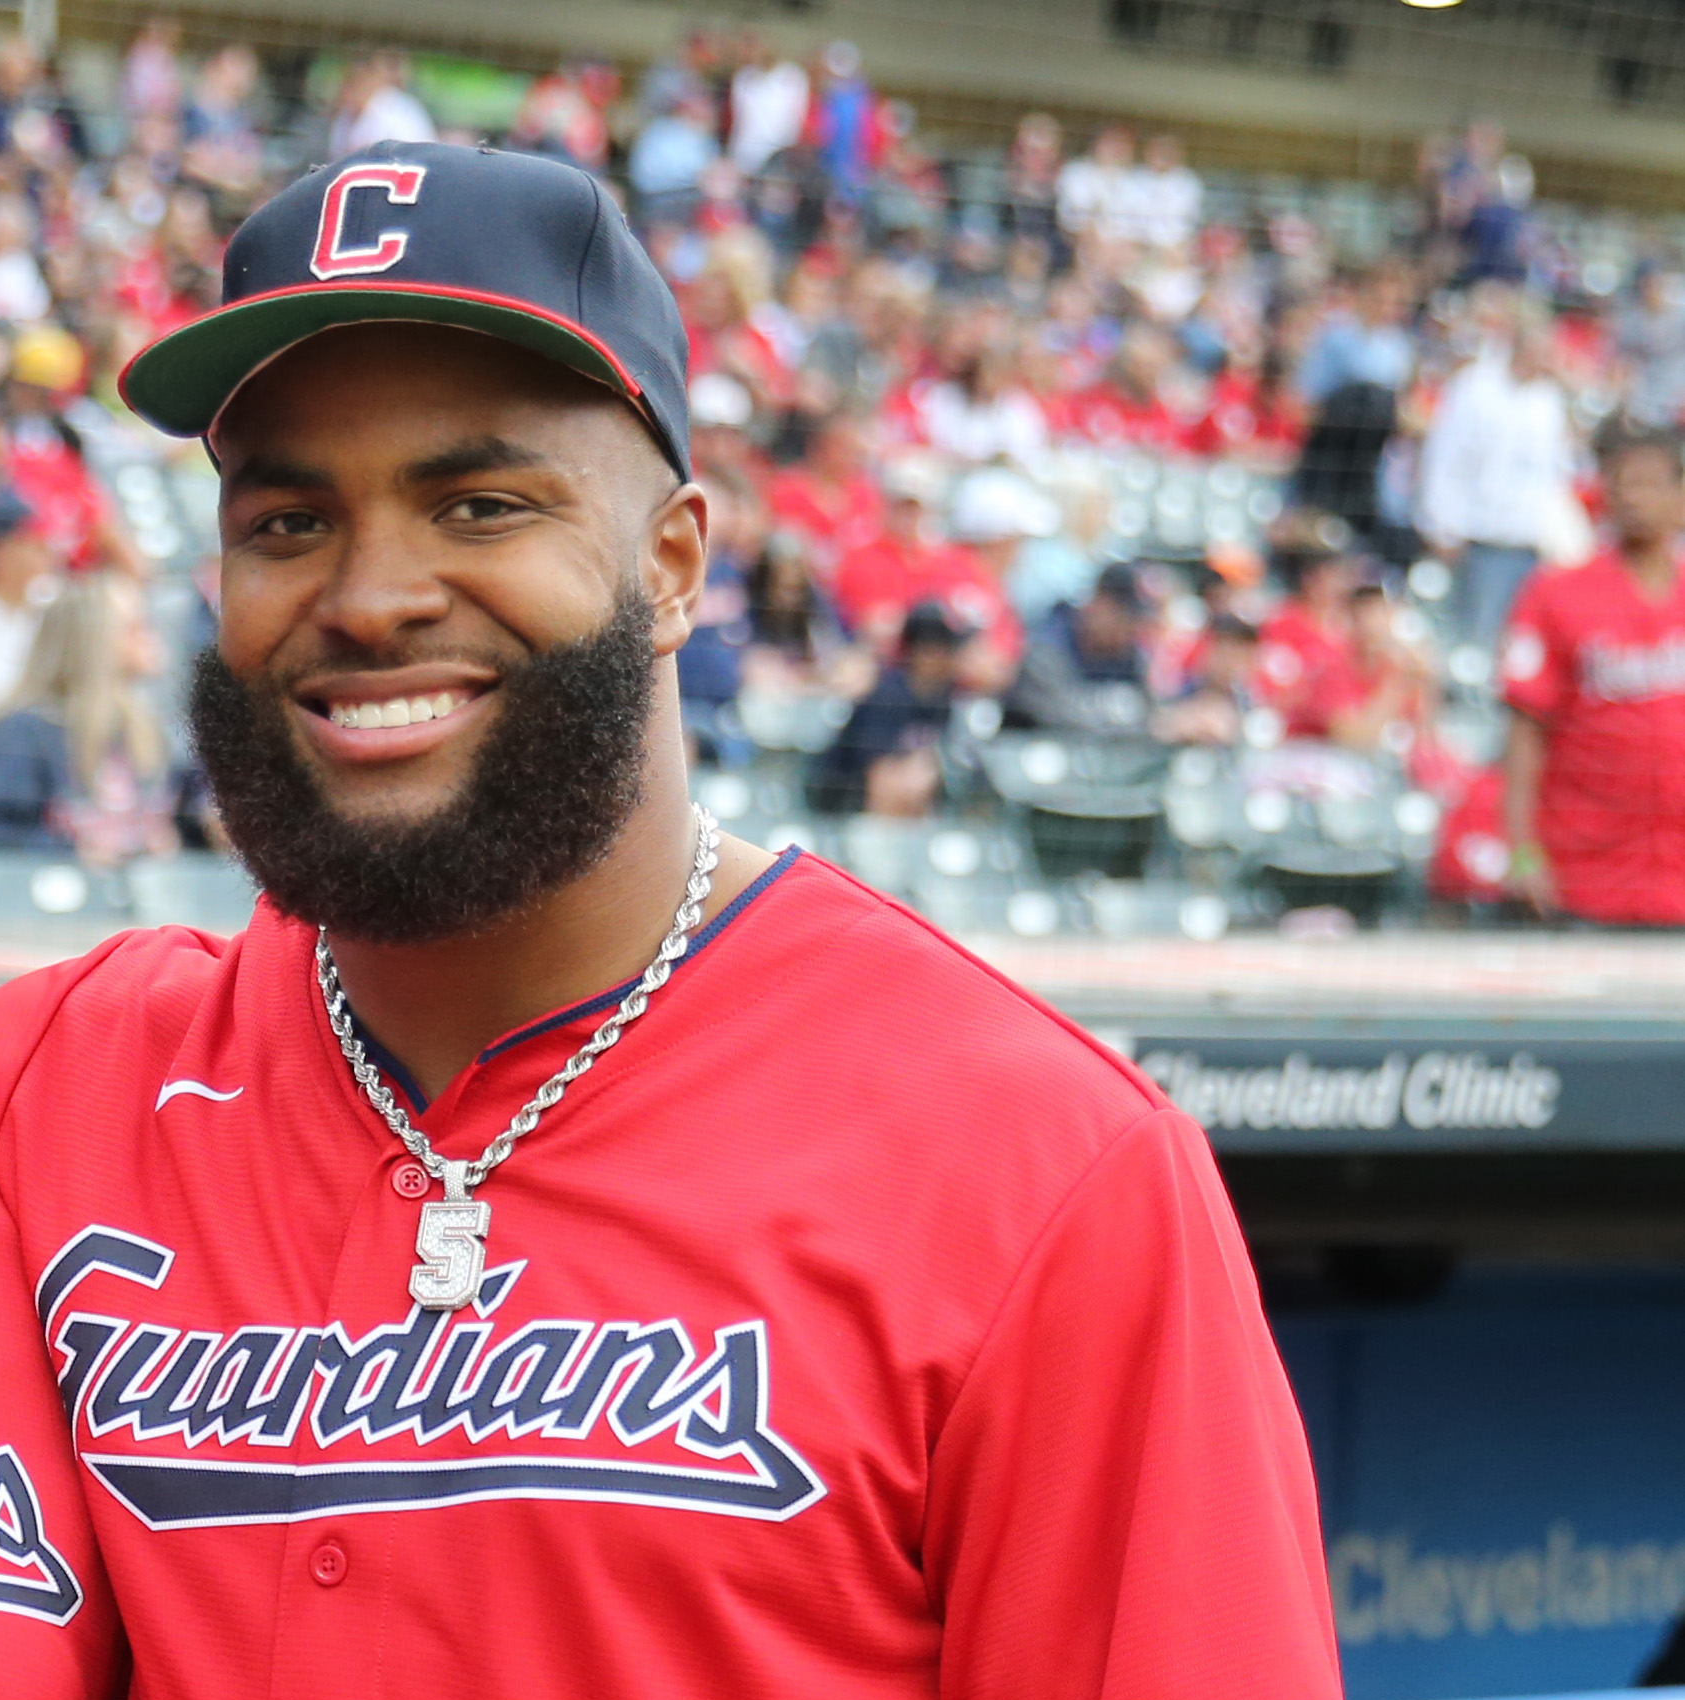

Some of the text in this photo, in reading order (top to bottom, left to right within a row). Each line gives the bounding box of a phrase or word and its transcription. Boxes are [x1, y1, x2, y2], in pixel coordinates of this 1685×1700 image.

[309, 164, 427, 281] C
[1402, 1050, 1561, 1131] Clinic
[35, 1225, 828, 1532] Guardians
